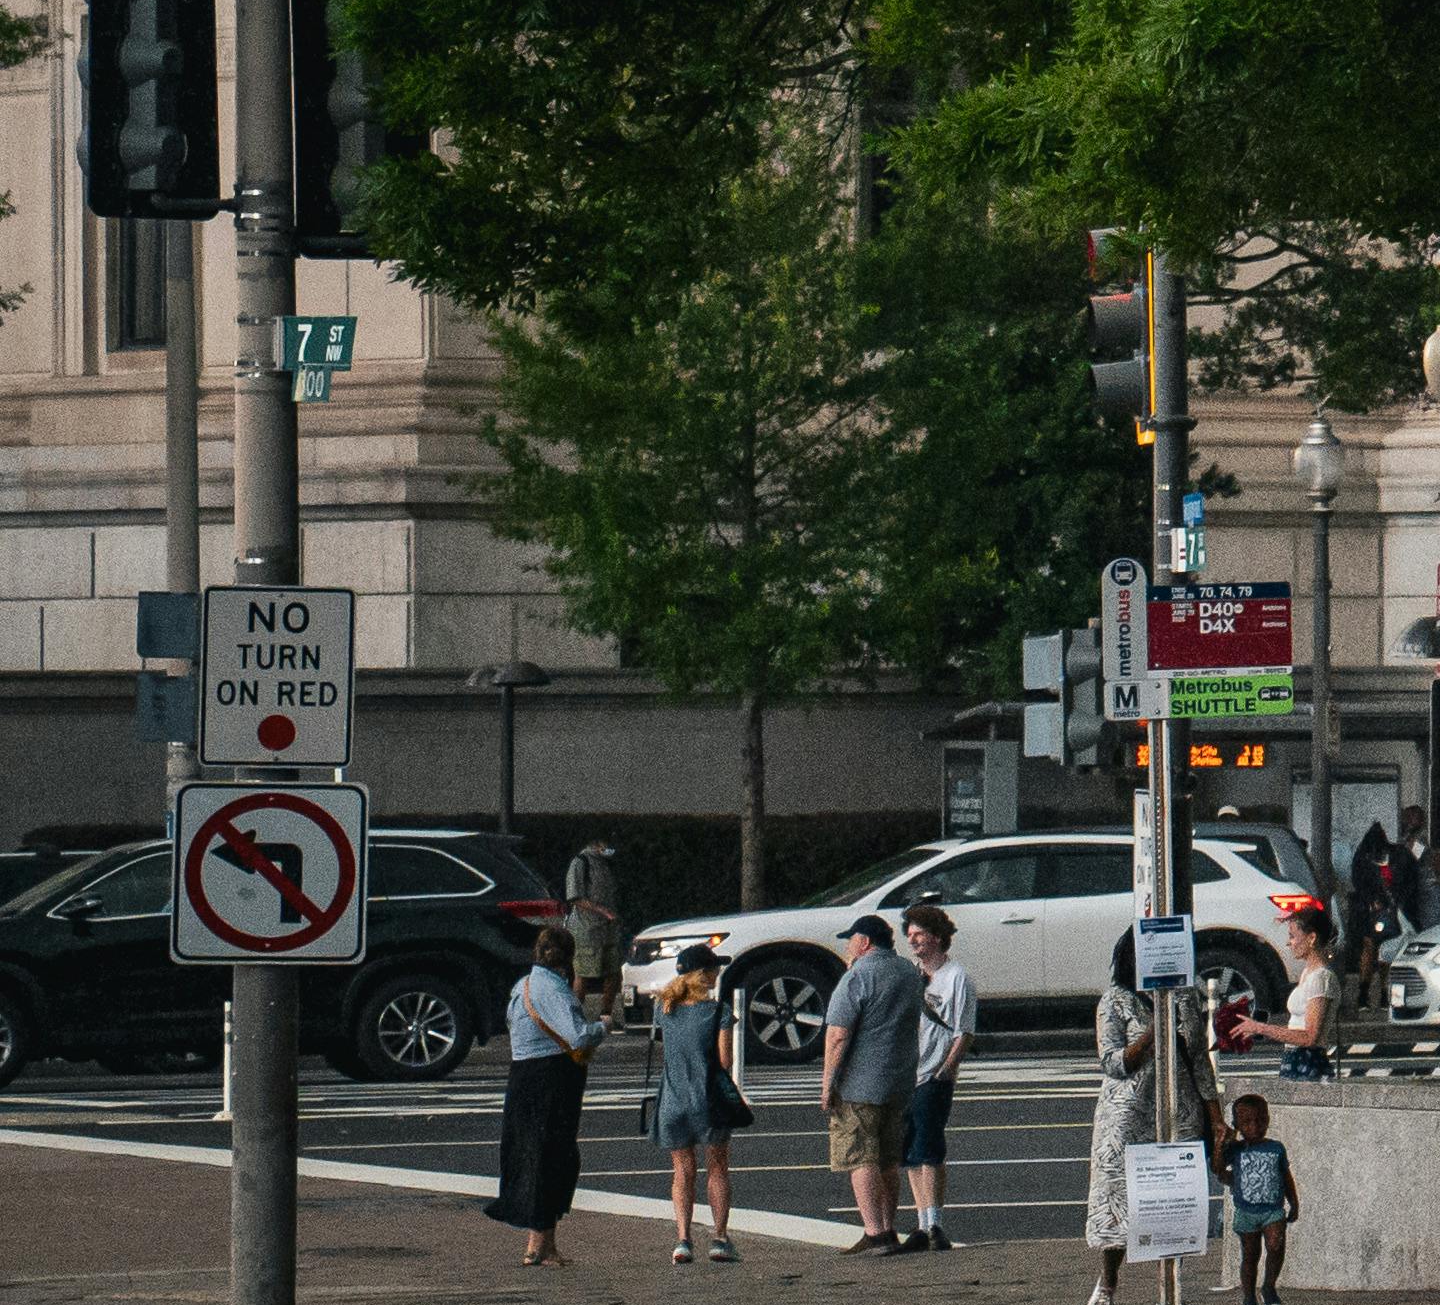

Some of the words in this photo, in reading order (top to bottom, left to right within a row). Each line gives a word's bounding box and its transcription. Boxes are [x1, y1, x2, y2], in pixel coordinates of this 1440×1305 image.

[297, 324, 313, 362] 7
[329, 325, 345, 343] ST
[325, 344, 344, 362] NW
[1200, 587, 1216, 599] 70,
[1219, 586, 1236, 598] 74,
[1238, 586, 1253, 597] 79
[248, 601, 310, 634] NO
[1200, 602, 1234, 617] D40
[1116, 589, 1132, 677] metrobus
[1200, 618, 1235, 634] D4X
[236, 644, 321, 671] TURN
[216, 679, 259, 706] ON
[277, 680, 338, 707] RED
[1171, 678, 1253, 695] Metrobus
[1115, 685, 1138, 709] M
[1113, 710, 1141, 718] metro
[1171, 698, 1256, 715] SHUTTLE
